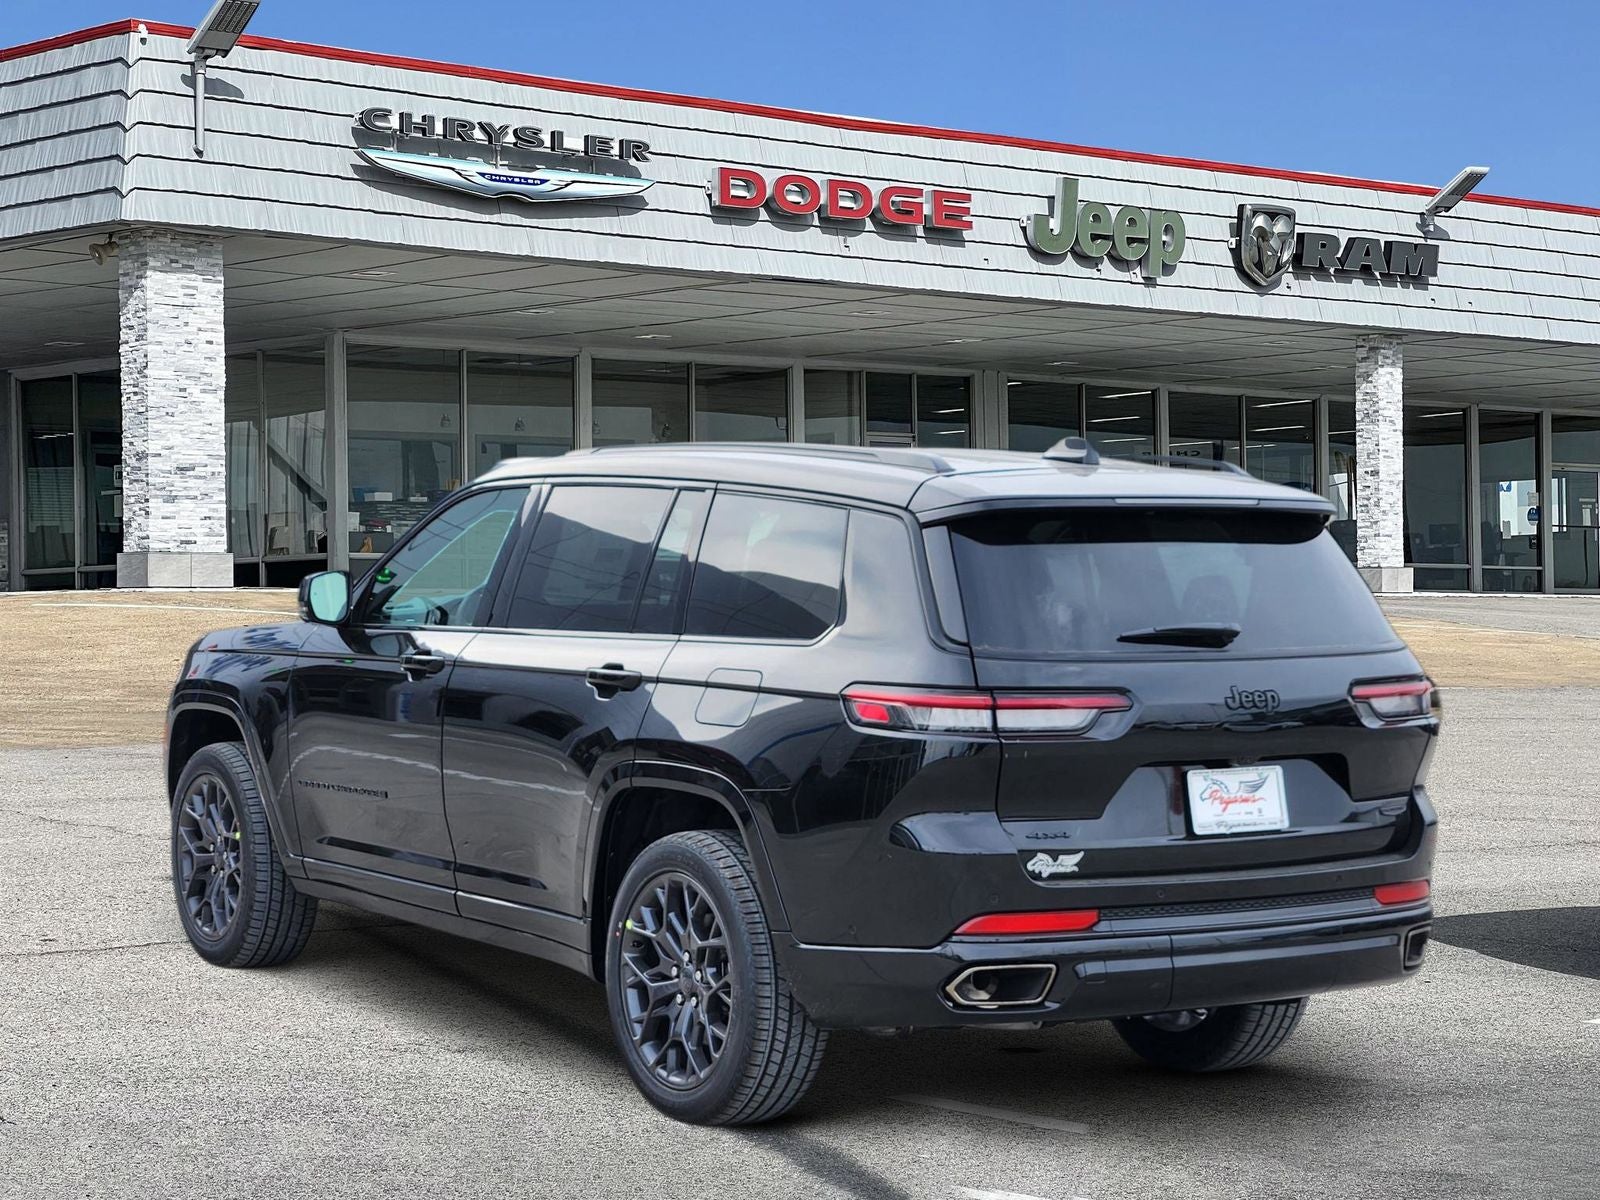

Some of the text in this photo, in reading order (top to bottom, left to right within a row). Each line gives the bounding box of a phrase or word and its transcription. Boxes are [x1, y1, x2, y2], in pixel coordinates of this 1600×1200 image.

[358, 107, 651, 162] CHRYSLER
[484, 174, 541, 185] CHRYSLER
[712, 166, 974, 231] DODGE
[1026, 177, 1187, 279] Jeep
[1300, 231, 1440, 277] RAM
[1224, 685, 1280, 714] Jeep
